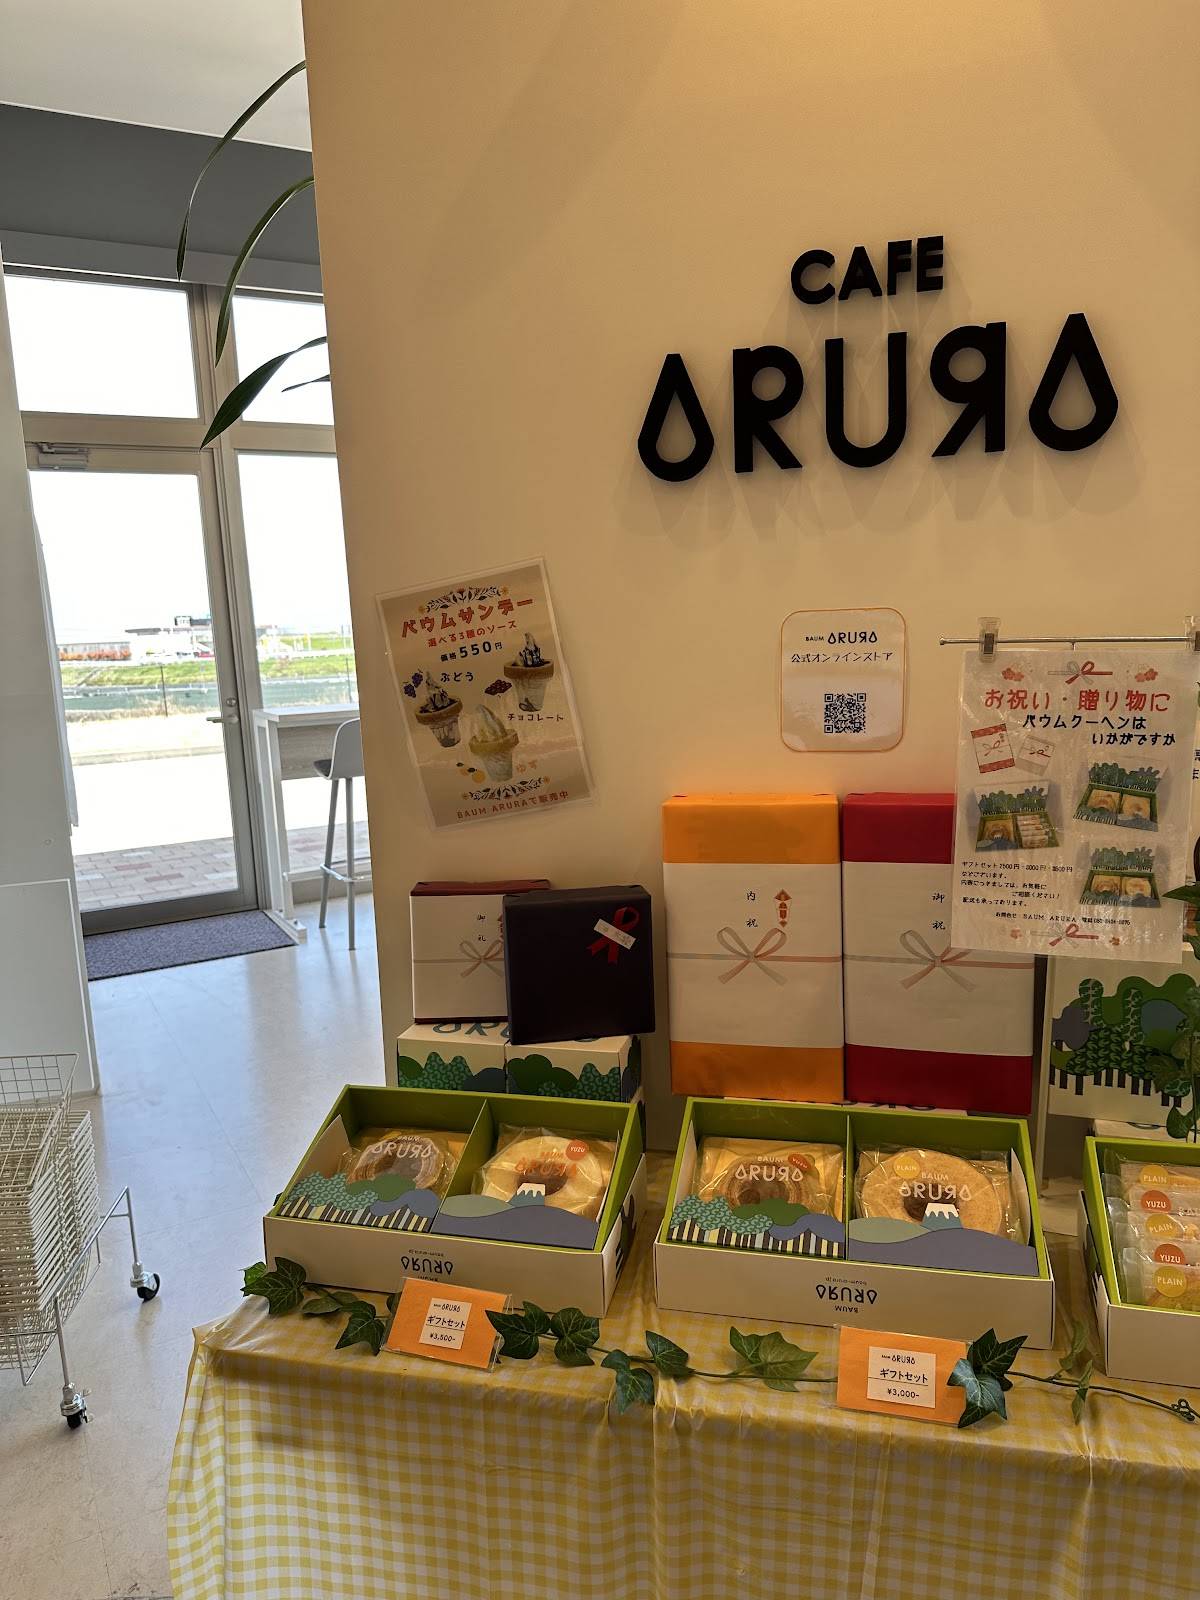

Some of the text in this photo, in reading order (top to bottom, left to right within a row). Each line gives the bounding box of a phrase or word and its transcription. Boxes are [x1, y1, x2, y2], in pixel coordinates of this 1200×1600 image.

[791, 235, 944, 304] CAFE
[637, 312, 1119, 482] ARURA
[827, 631, 878, 644] ARURA
[791, 651, 894, 663] 公式オンラインストア
[440, 671, 474, 682] ぶどう
[984, 687, 1171, 712] お祝い・贈り物に
[507, 713, 564, 721] チョコレート
[1022, 713, 1147, 730] バウムクーヘンは
[1092, 732, 1176, 746] いかがですか
[932, 893, 945, 930] 御祝
[896, 1164, 917, 1172] PLAIN
[921, 1171, 949, 1180] BAUM
[1143, 1174, 1167, 1183] PLAIN
[1145, 1200, 1166, 1209] YUZU
[1149, 1223, 1173, 1233] PLAIN
[1160, 1254, 1181, 1263] YUZU
[1157, 1276, 1183, 1286] PLAIN
[427, 1316, 465, 1329] ギフトセット
[430, 1333, 455, 1342] ¥3,500-
[879, 1368, 928, 1384] ギフトセット
[887, 1388, 920, 1399] ¥3,000-
